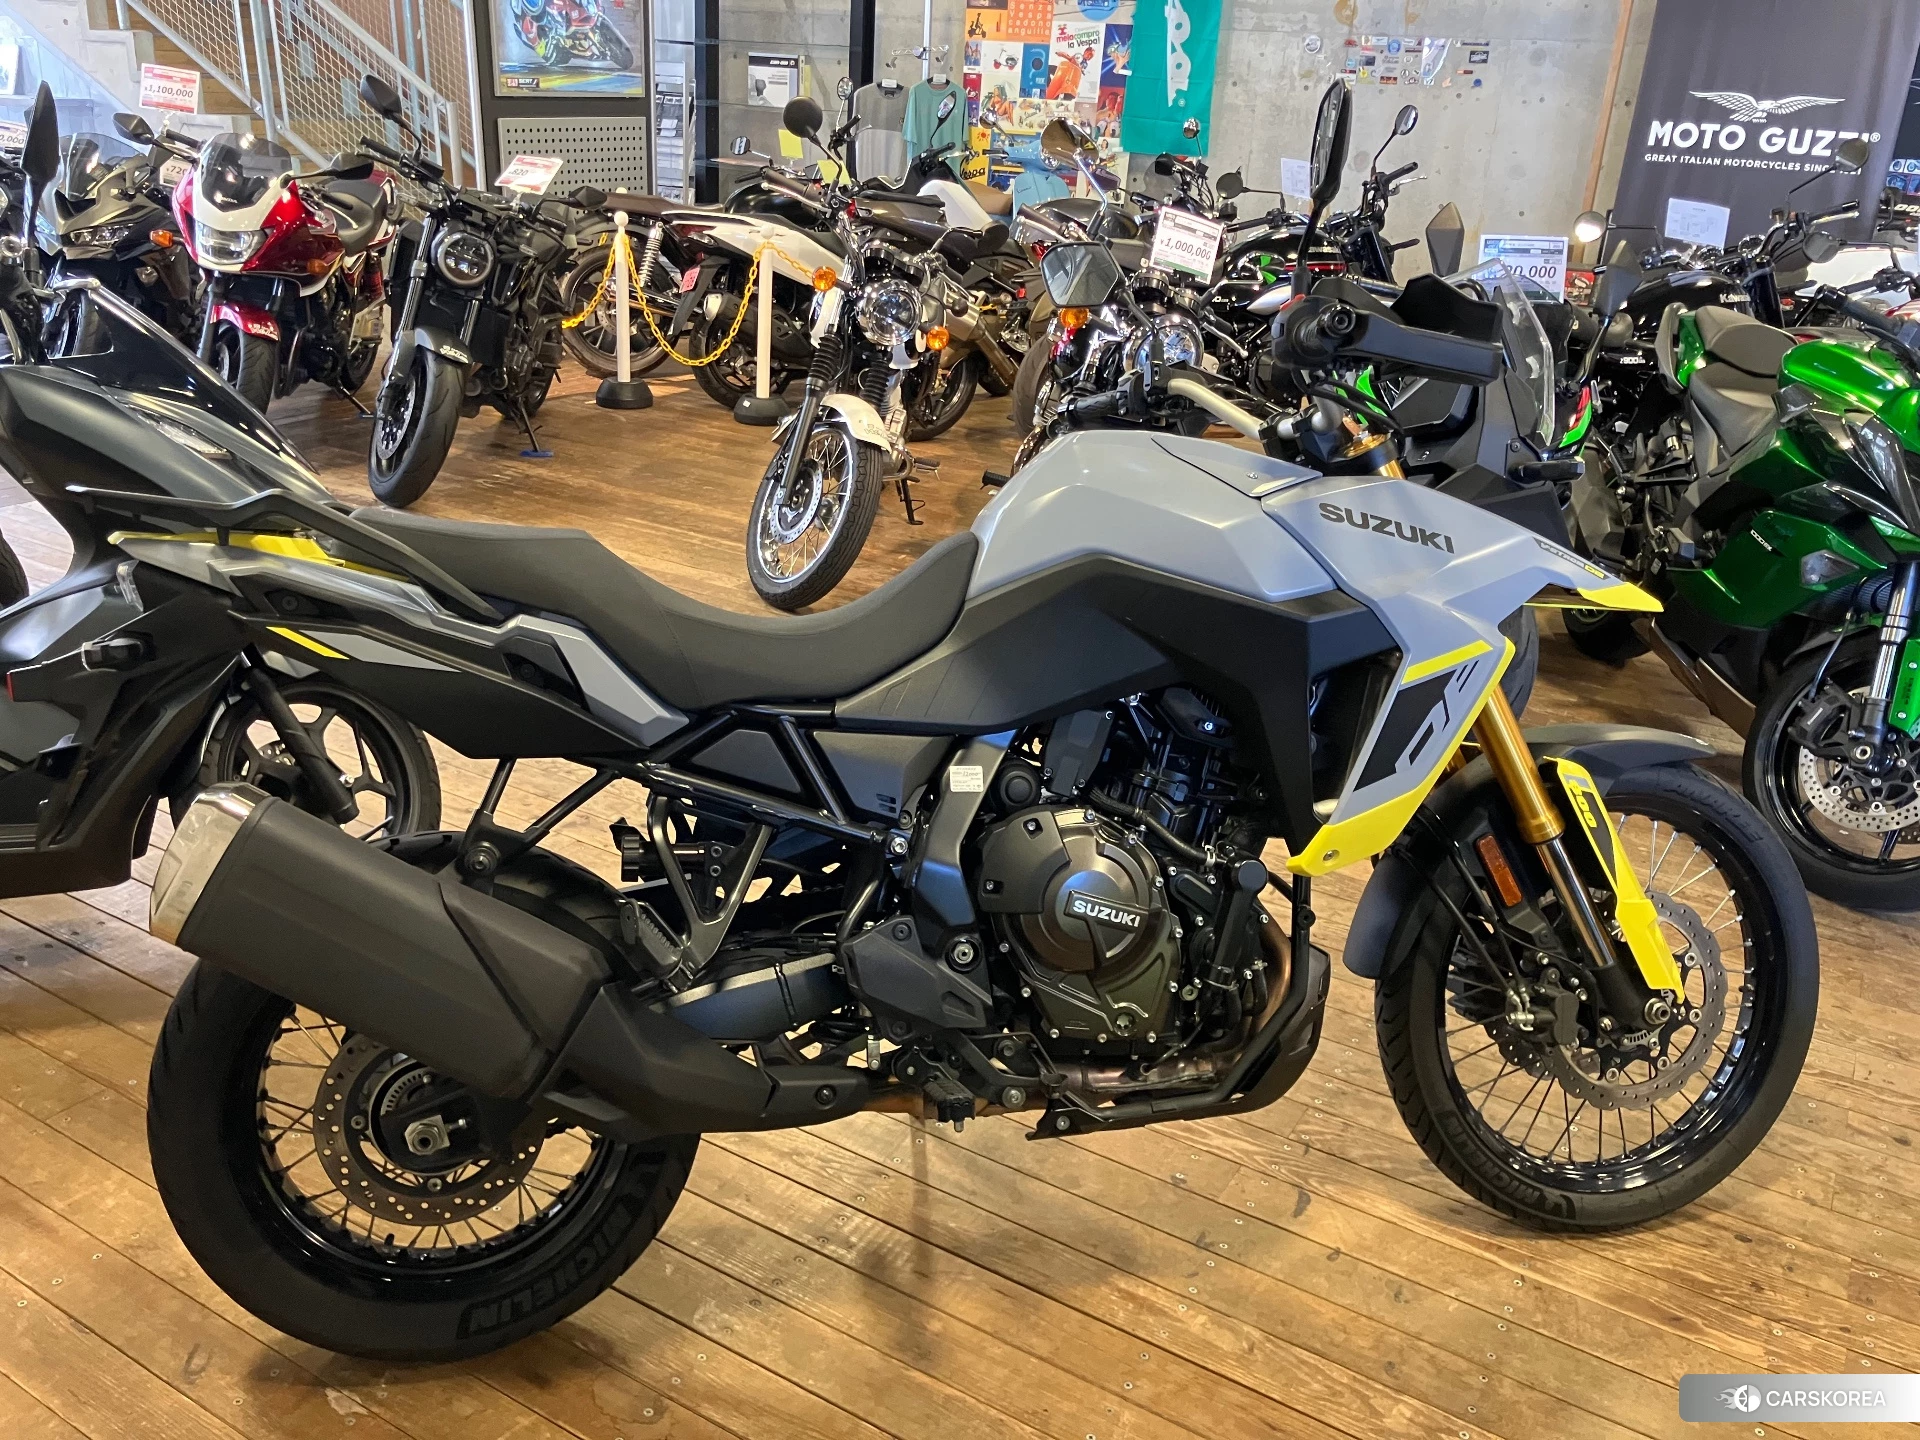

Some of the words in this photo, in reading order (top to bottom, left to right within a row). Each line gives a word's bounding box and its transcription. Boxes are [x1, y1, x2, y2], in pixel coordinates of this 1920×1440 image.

[1647, 120, 1746, 151] MOTO
[1644, 153, 1678, 163] GREAT
[1680, 156, 1721, 166] ITALIAN
[1723, 158, 1801, 171] MOTORCYCLES
[1803, 163, 1836, 174] SINC
[1318, 502, 1456, 555] SUZUKI
[1568, 779, 1597, 828] 800
[1072, 900, 1141, 928] SUZUKI
